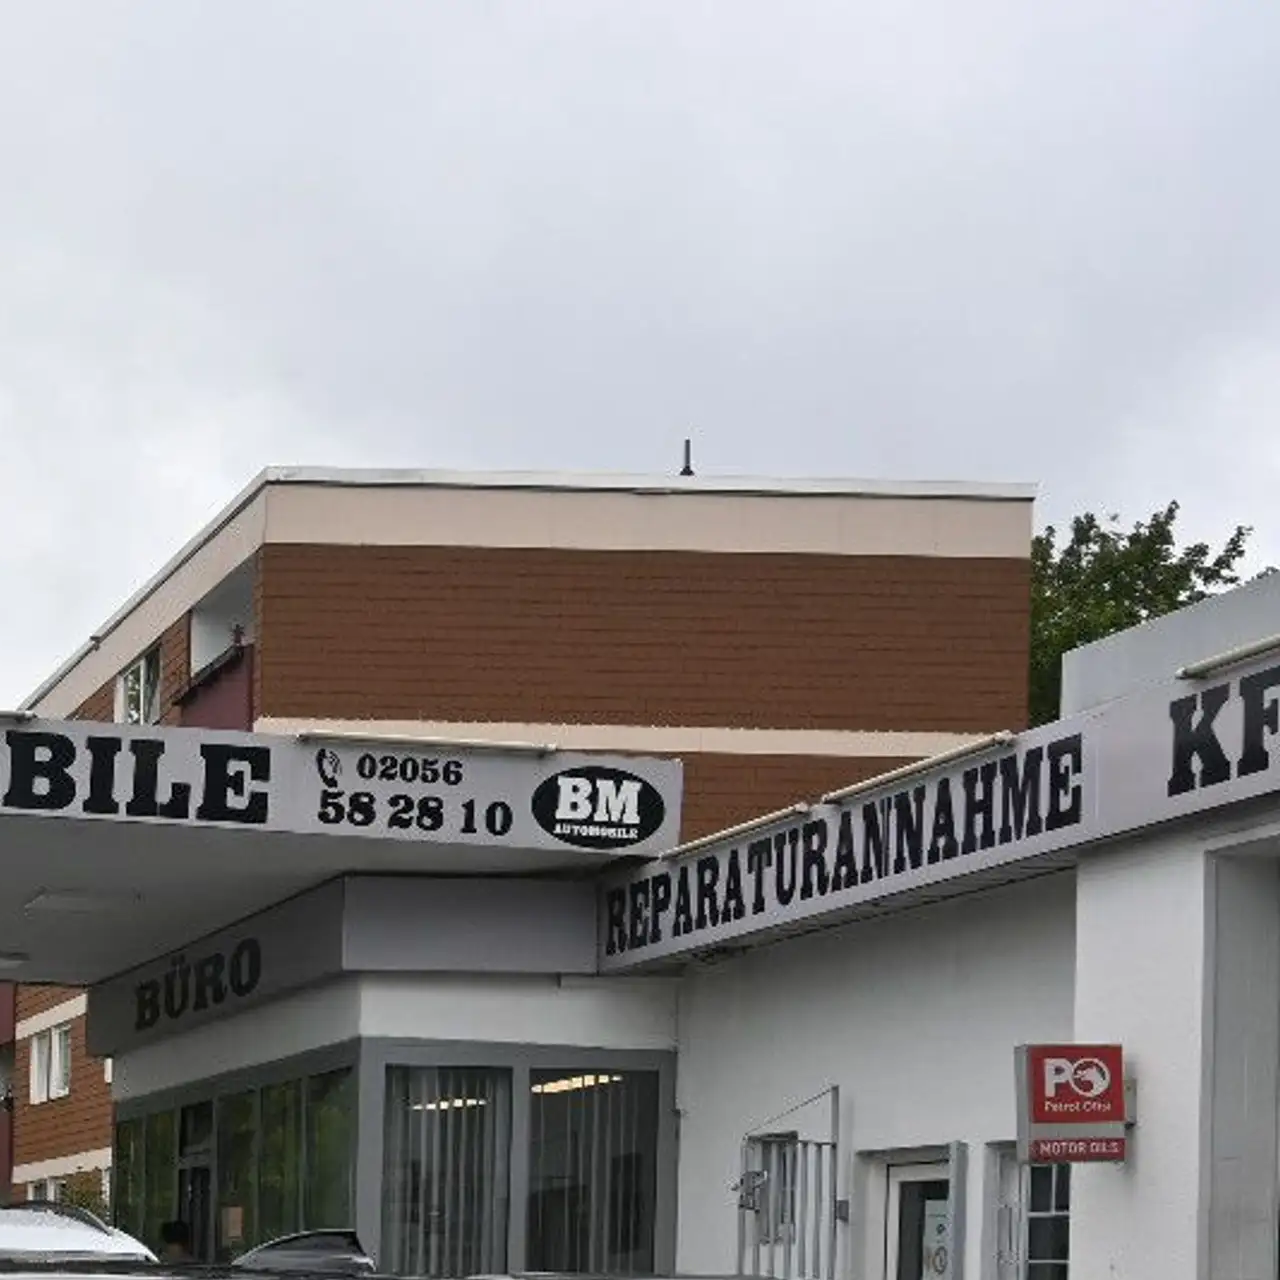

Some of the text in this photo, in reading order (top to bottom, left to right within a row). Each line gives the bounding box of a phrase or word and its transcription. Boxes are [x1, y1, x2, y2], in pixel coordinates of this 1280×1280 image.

[356, 753, 463, 785] 02056
[317, 790, 513, 836] 58 28 10
[555, 777, 642, 824] BM
[553, 824, 639, 839] AUTOMOBILE
[605, 734, 1083, 957] REPARATURANNAHME
[134, 938, 262, 1032] BÜRO
[1040, 1141, 1119, 1155] MOTOR OILS
